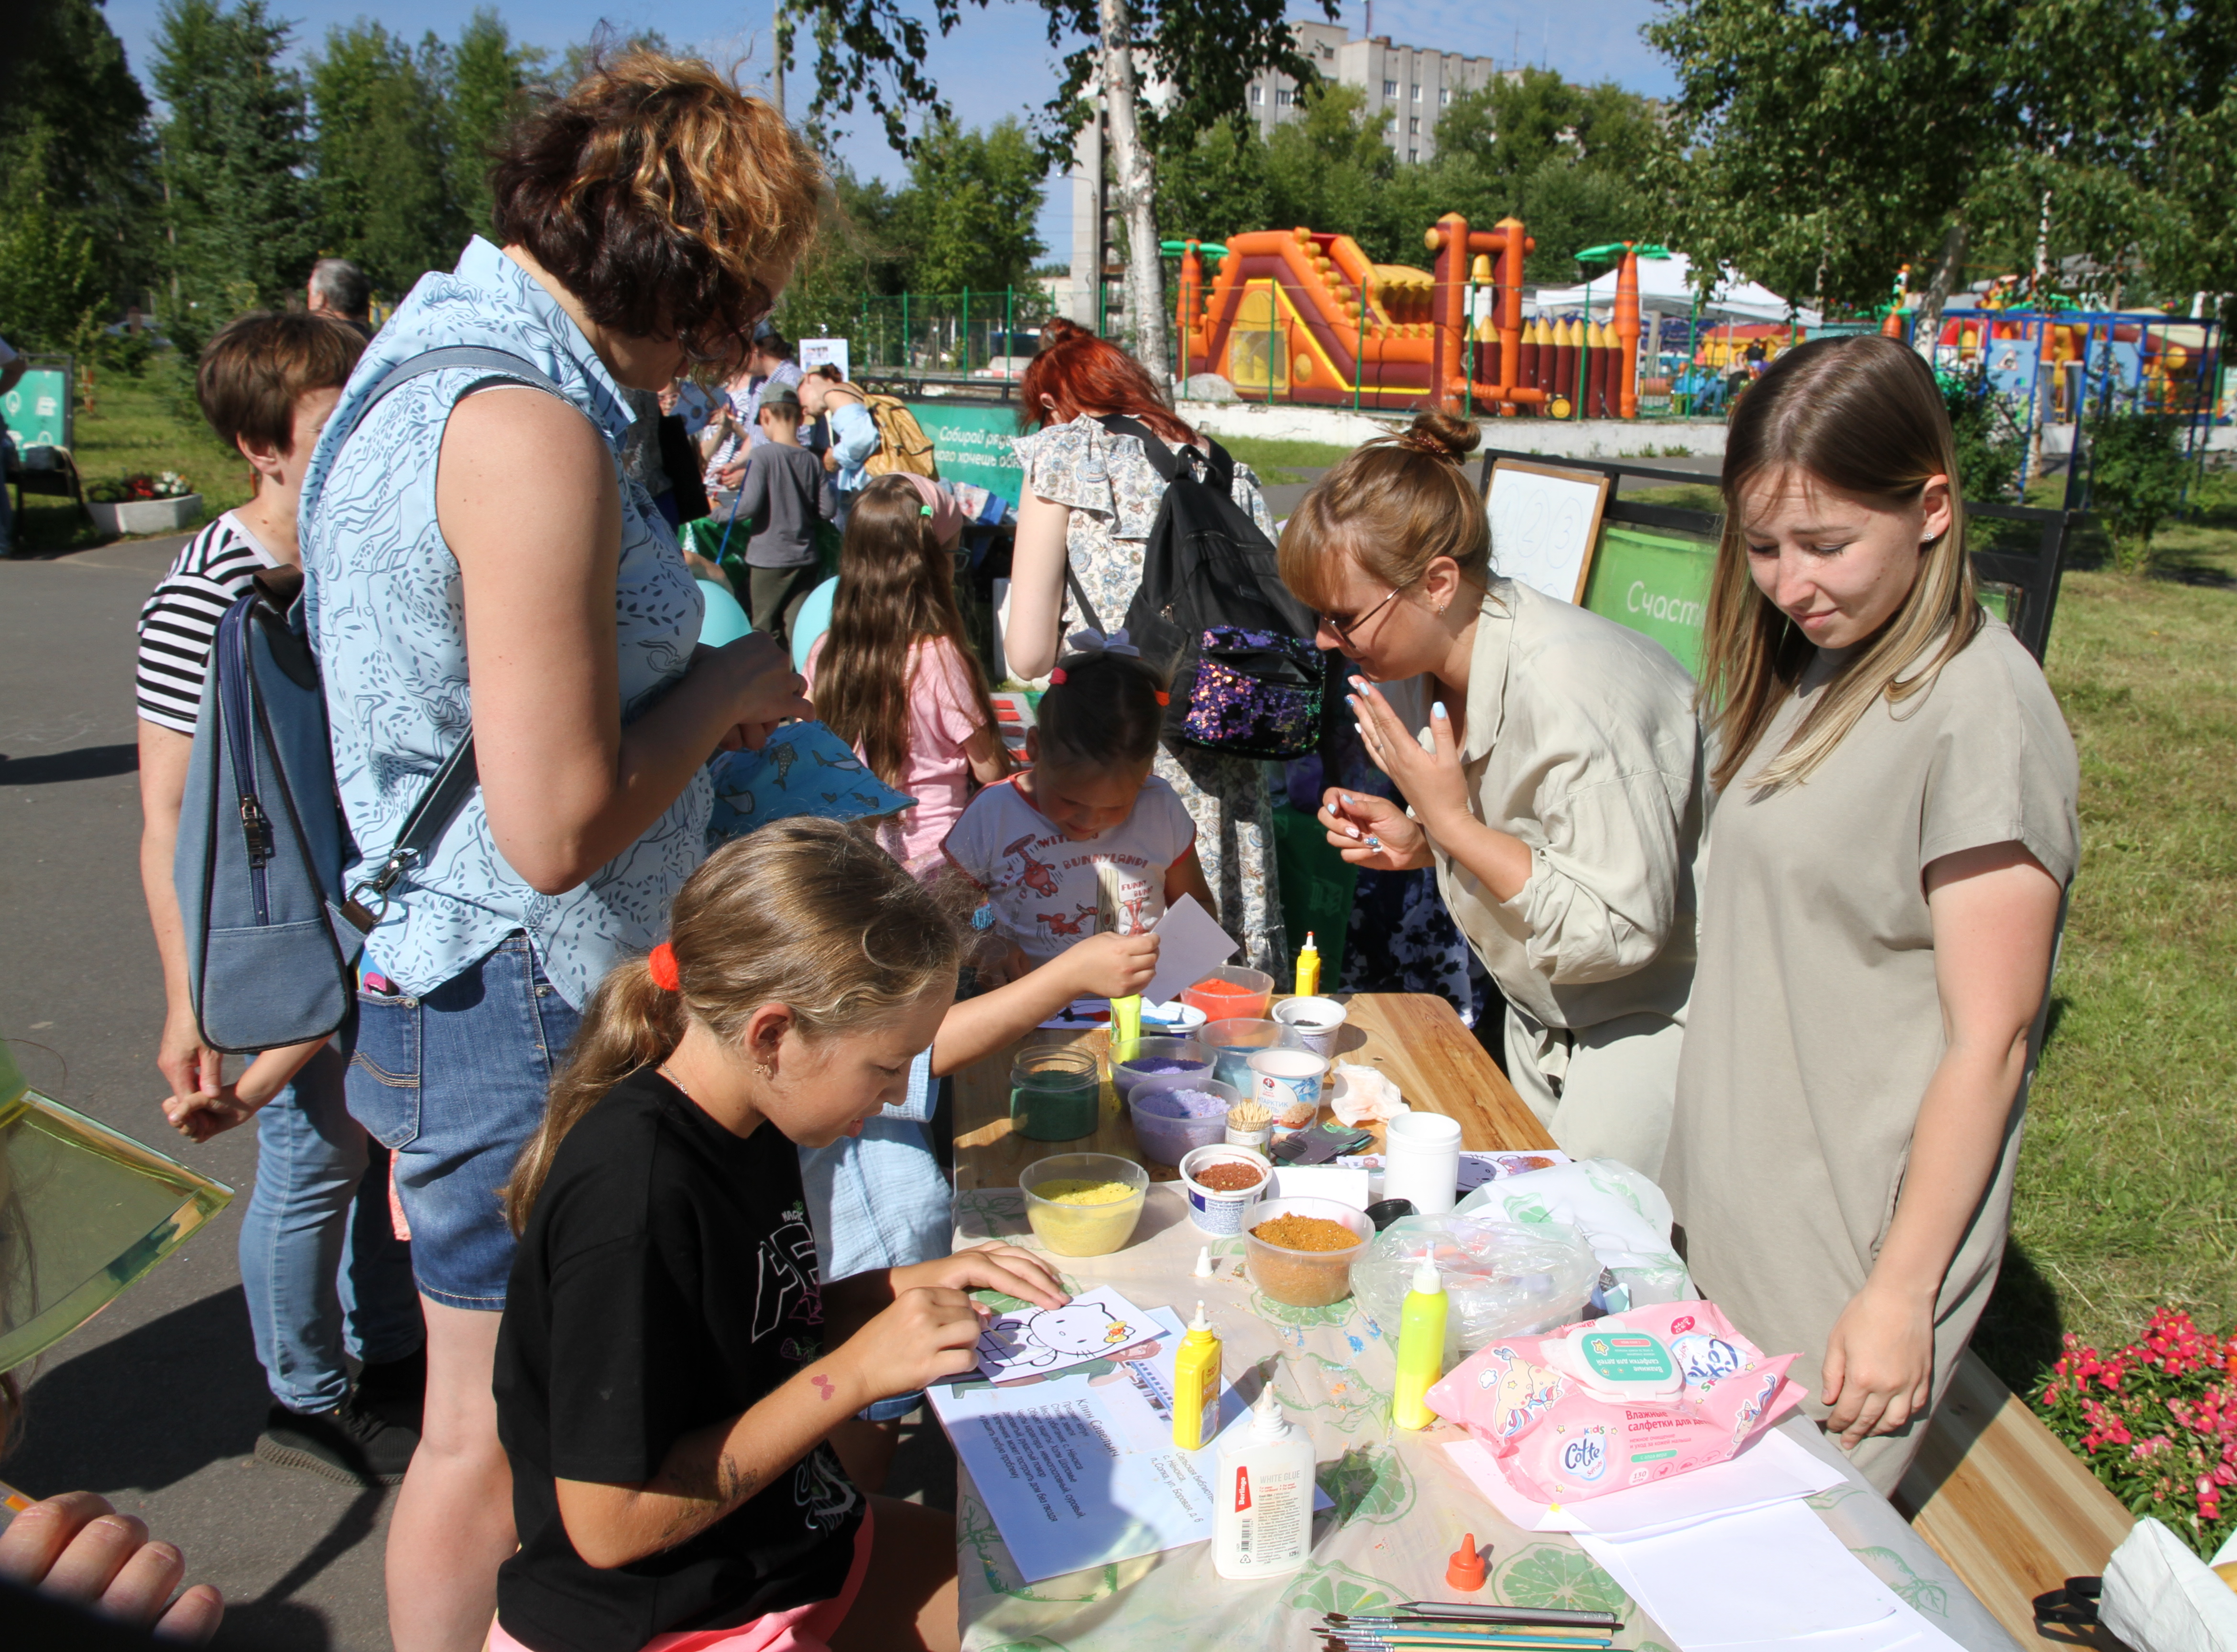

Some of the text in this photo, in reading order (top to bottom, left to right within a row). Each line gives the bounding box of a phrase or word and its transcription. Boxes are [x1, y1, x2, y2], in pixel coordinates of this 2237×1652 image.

[939, 425, 1015, 450] Собирай рядо
[934, 449, 1023, 469] кого хочешь обн
[1627, 580, 1706, 628] Счаст
[1037, 834, 1071, 848] WIT
[1062, 853, 1149, 870] BUNNYLAND!
[1121, 880, 1147, 891] FUNNY
[781, 1209, 804, 1222] MAGIC
[1629, 1358, 1659, 1366] салфетки
[1039, 1405, 1052, 1421] Место
[1626, 1410, 1668, 1420] Влажные
[1027, 1407, 1042, 1426] Объект
[1037, 1425, 1054, 1444] защиты:
[1050, 1444, 1063, 1458] Холм
[1062, 1422, 1076, 1436] земля
[1076, 1399, 1120, 1457] Клин Савельич
[1628, 1420, 1673, 1432] салфетки
[1675, 1419, 1691, 1427] для
[980, 1418, 996, 1437] решить
[991, 1436, 1006, 1455] любую
[1000, 1453, 1020, 1479] проблему
[1017, 1438, 1039, 1461] рукастый
[1032, 1460, 1047, 1478] помор
[1565, 1438, 1600, 1469] Cotte
[1016, 1409, 1028, 1425] Черты
[1024, 1424, 1044, 1450] характера:
[1064, 1494, 1086, 1519] суровый,
[1176, 1452, 1197, 1476] Сельская
[1006, 1439, 1021, 1456] может
[1015, 1456, 1034, 1482] построить
[1029, 1482, 1042, 1493] дом
[1036, 1492, 1047, 1504] без
[1043, 1504, 1058, 1522] гвоздя
[1260, 1469, 1301, 1484] WHITE GLUE
[1633, 1470, 1647, 1479] 130
[1239, 1477, 1247, 1505] Berlingo
